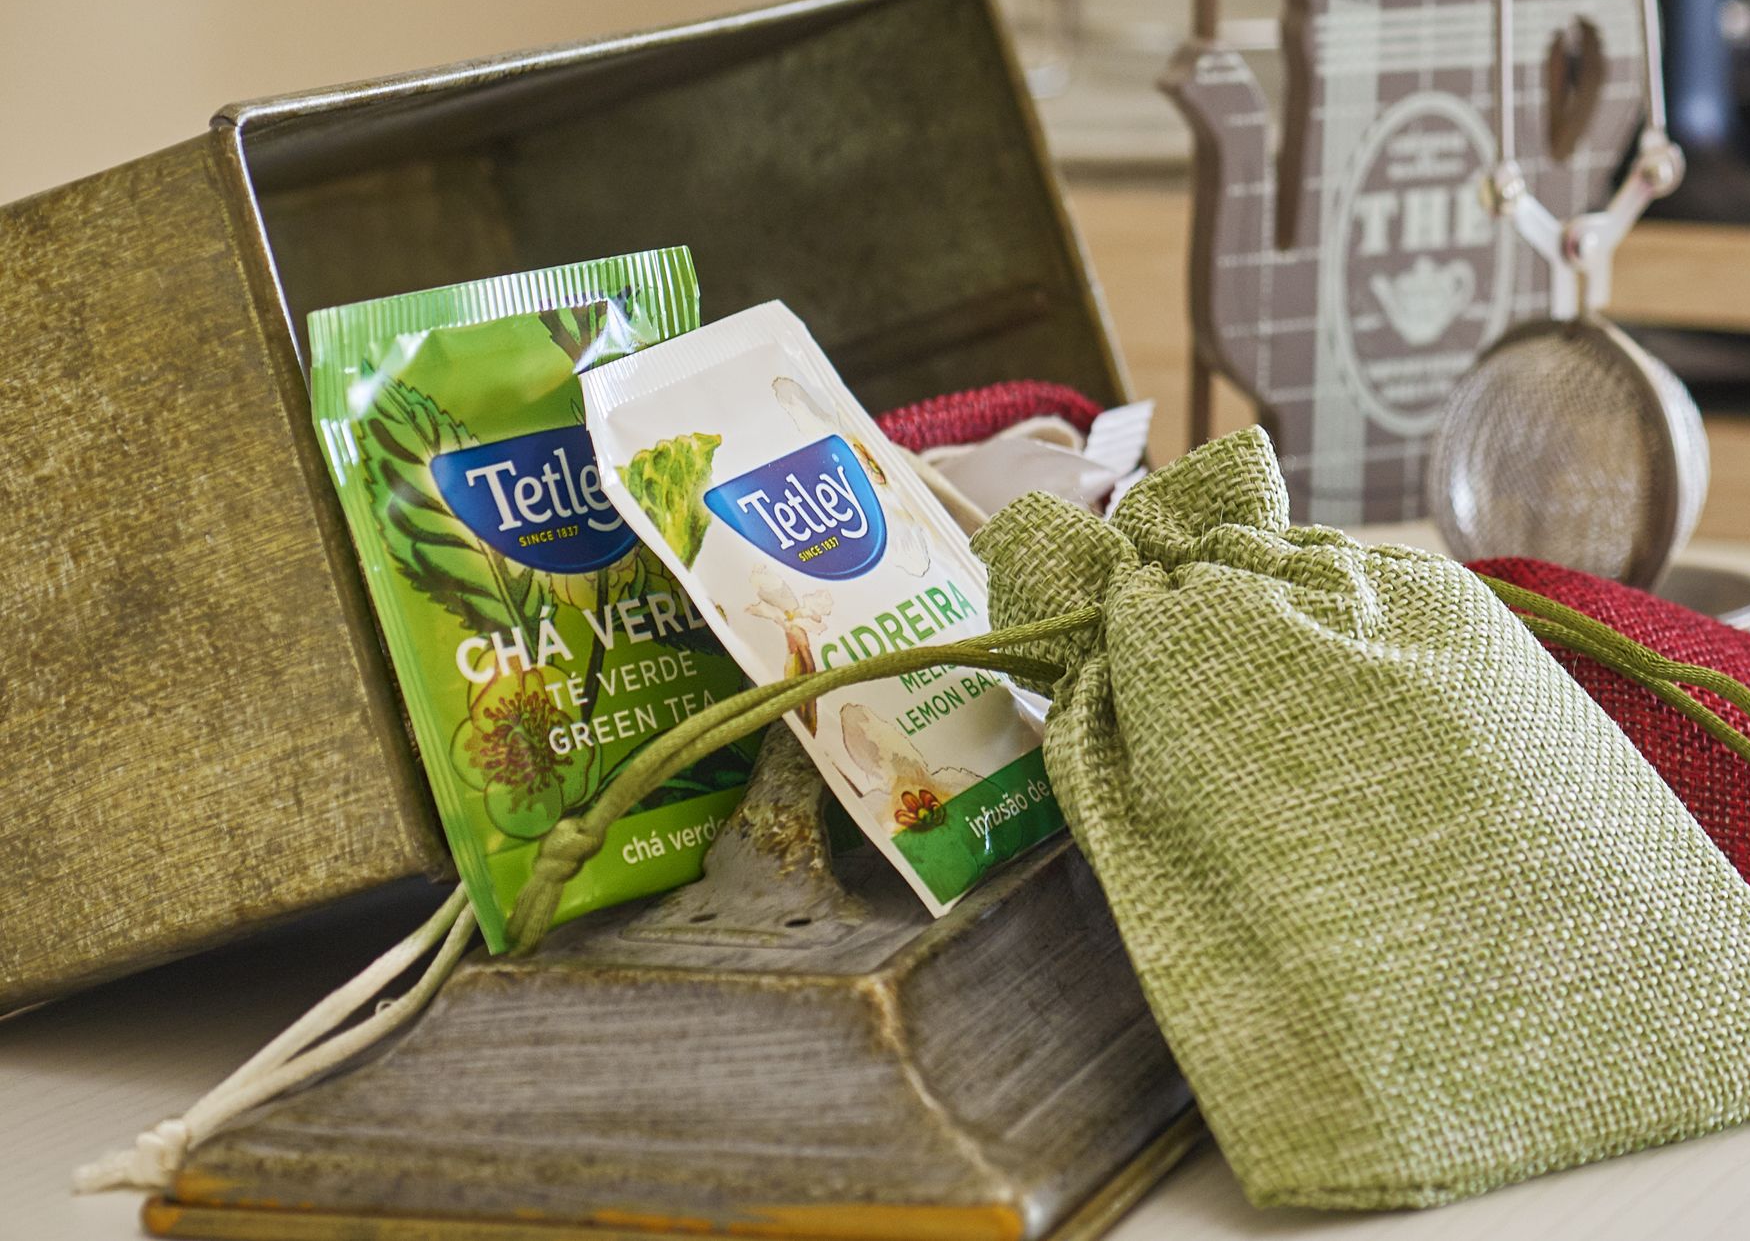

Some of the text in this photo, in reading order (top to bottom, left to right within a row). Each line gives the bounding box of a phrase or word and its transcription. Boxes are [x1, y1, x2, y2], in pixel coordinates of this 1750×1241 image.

[736, 465, 869, 550] Tetley
[518, 525, 579, 547] SINCE 1837
[799, 536, 840, 561] SINCE 1837
[456, 605, 574, 684] CHÁ
[820, 579, 978, 671] CIDREIRA
[545, 650, 698, 710] TÉ VERDE
[549, 704, 657, 755] GREEN
[895, 686, 966, 736] LEMON
[1027, 779, 1050, 802] de
[622, 830, 666, 865] chá
